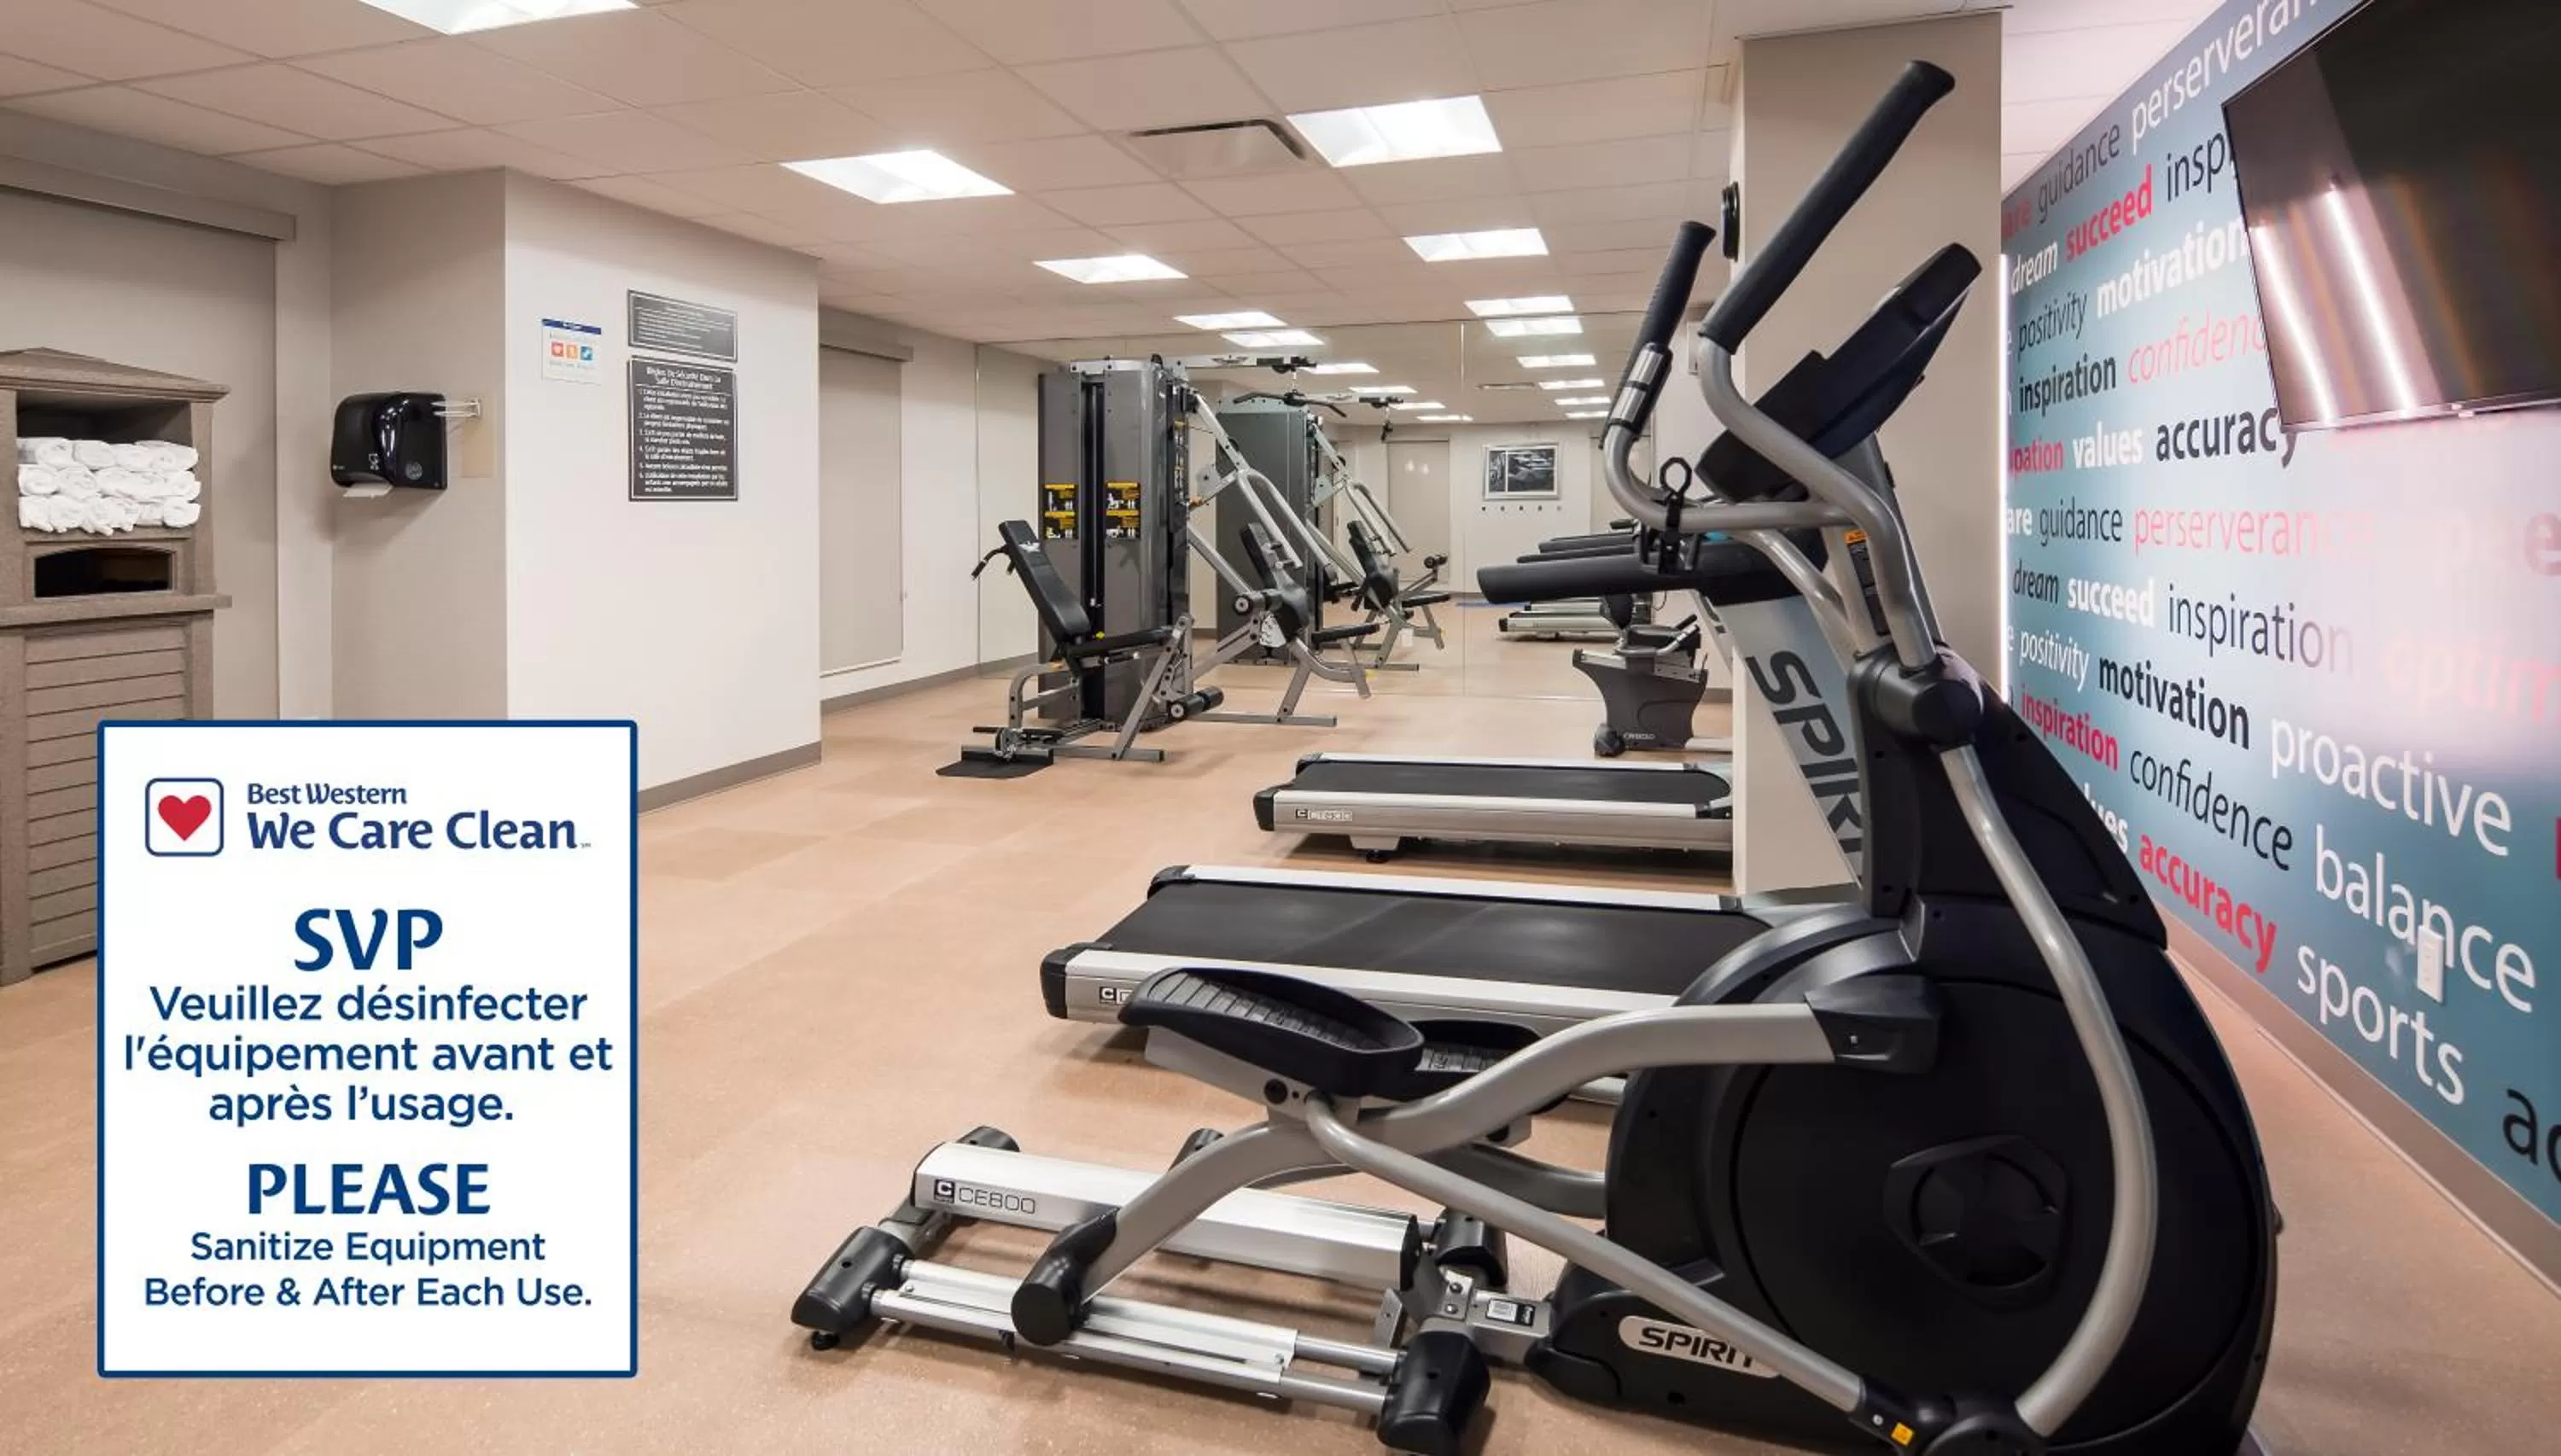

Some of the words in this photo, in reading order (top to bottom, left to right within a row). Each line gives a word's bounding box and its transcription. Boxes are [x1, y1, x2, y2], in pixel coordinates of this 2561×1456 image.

[2011, 239, 2058, 294] dream
[2065, 163, 2152, 262] succeed
[2167, 132, 2234, 202] insp
[2038, 124, 2121, 224] guidance
[2017, 290, 2087, 361] positivity
[2097, 217, 2250, 319] motivation
[2019, 354, 2117, 416] inspiration
[2127, 303, 2267, 386] confidenc
[2073, 421, 2144, 469] values
[2039, 495, 2123, 546] guidance
[2013, 558, 2059, 604] dream
[2067, 577, 2156, 628] succeed
[2168, 584, 2354, 674] inspiration
[1746, 650, 1862, 880] SPIR
[2020, 629, 2090, 693] positivity
[2098, 655, 2250, 750] motivation
[2271, 717, 2511, 857] proactive
[2021, 683, 2119, 772] inspiration
[2130, 749, 2294, 872] confidence
[2315, 825, 2536, 1013] balance
[2139, 834, 2278, 974] accuracy
[2297, 945, 2464, 1106] sports
[960, 1187, 1035, 1214] CE800
